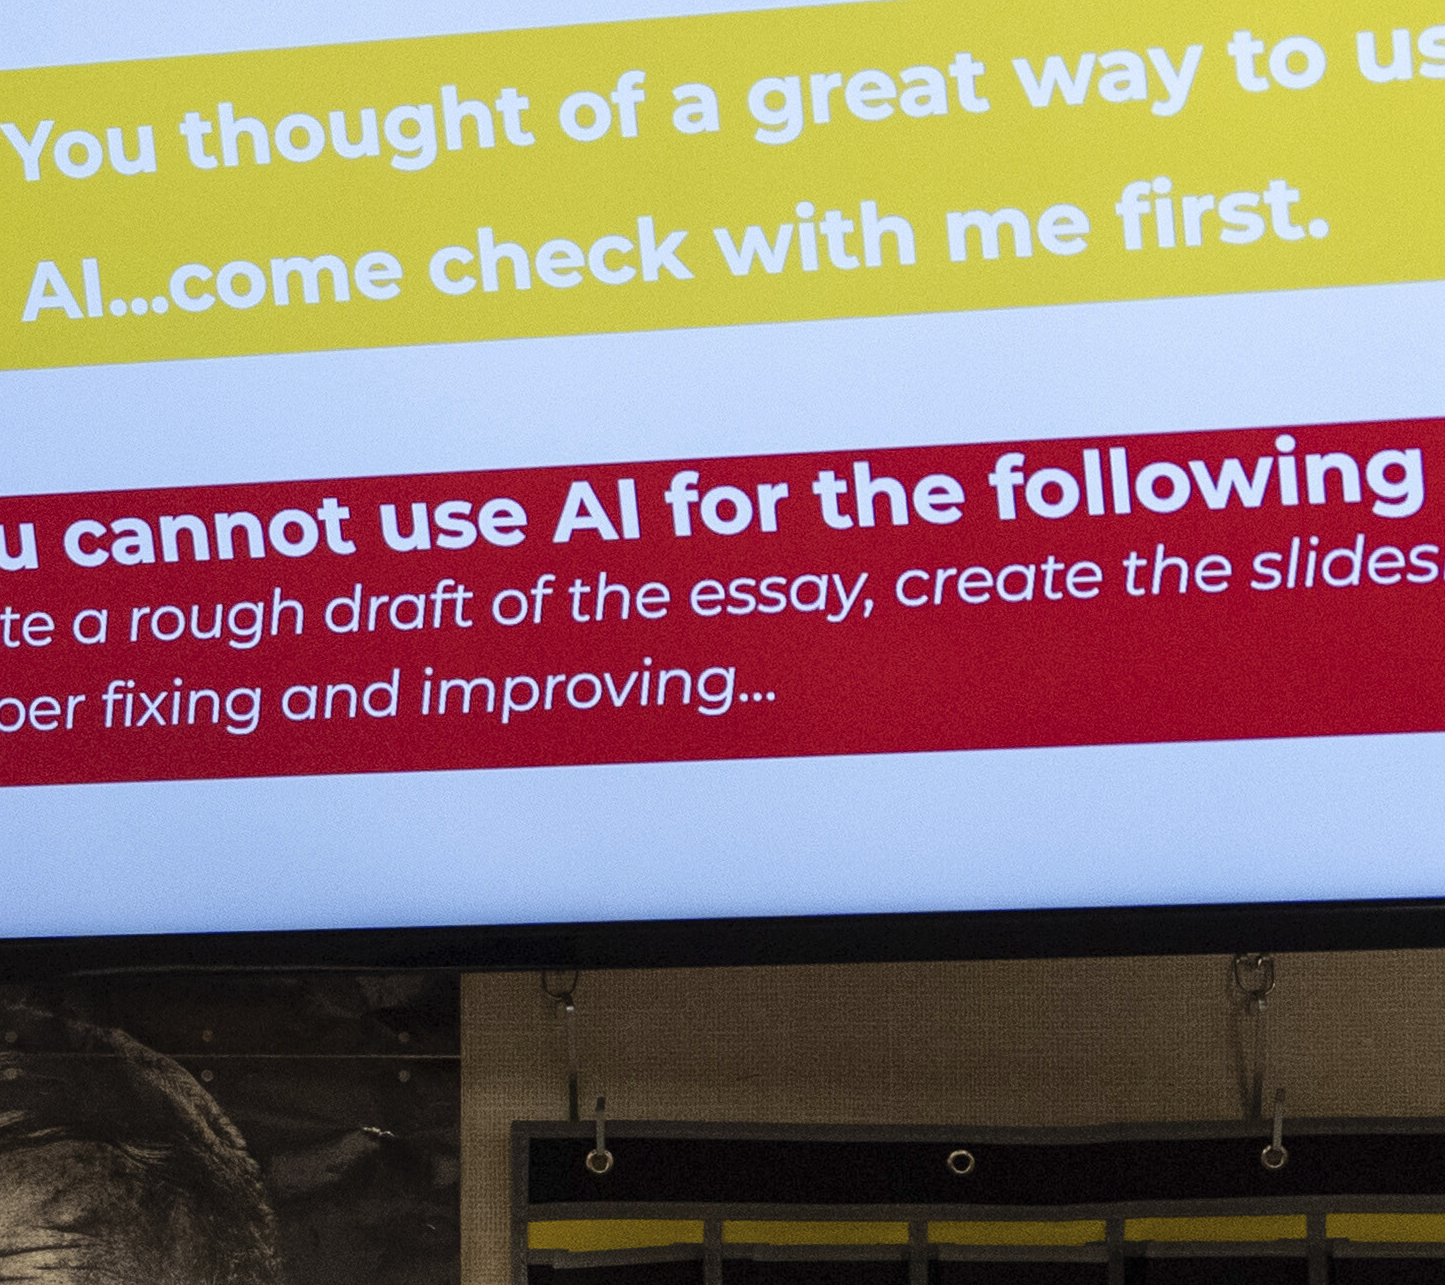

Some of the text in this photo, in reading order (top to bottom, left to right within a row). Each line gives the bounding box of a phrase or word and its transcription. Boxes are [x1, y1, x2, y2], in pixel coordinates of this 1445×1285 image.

[177, 83, 537, 173] thought
[557, 68, 647, 143] of
[671, 81, 721, 136] a
[746, 50, 992, 147] great
[1011, 43, 1205, 118] way
[1225, 28, 1328, 94] to
[21, 174, 1331, 323] AI...come check with me first.
[63, 497, 356, 568] cannot
[379, 497, 528, 552] use
[552, 477, 640, 544] AI
[663, 470, 789, 537] for
[811, 460, 965, 530] the
[987, 434, 1425, 521] following
[72, 609, 108, 645] a
[130, 587, 304, 650] rough
[324, 578, 474, 634] draft
[491, 573, 556, 626] of
[568, 571, 671, 623] the
[690, 572, 874, 623] essay,
[895, 555, 1103, 607] create
[1122, 543, 1233, 597] the
[101, 677, 262, 735] fixing
[281, 667, 400, 721] and
[421, 656, 776, 724] improving...
